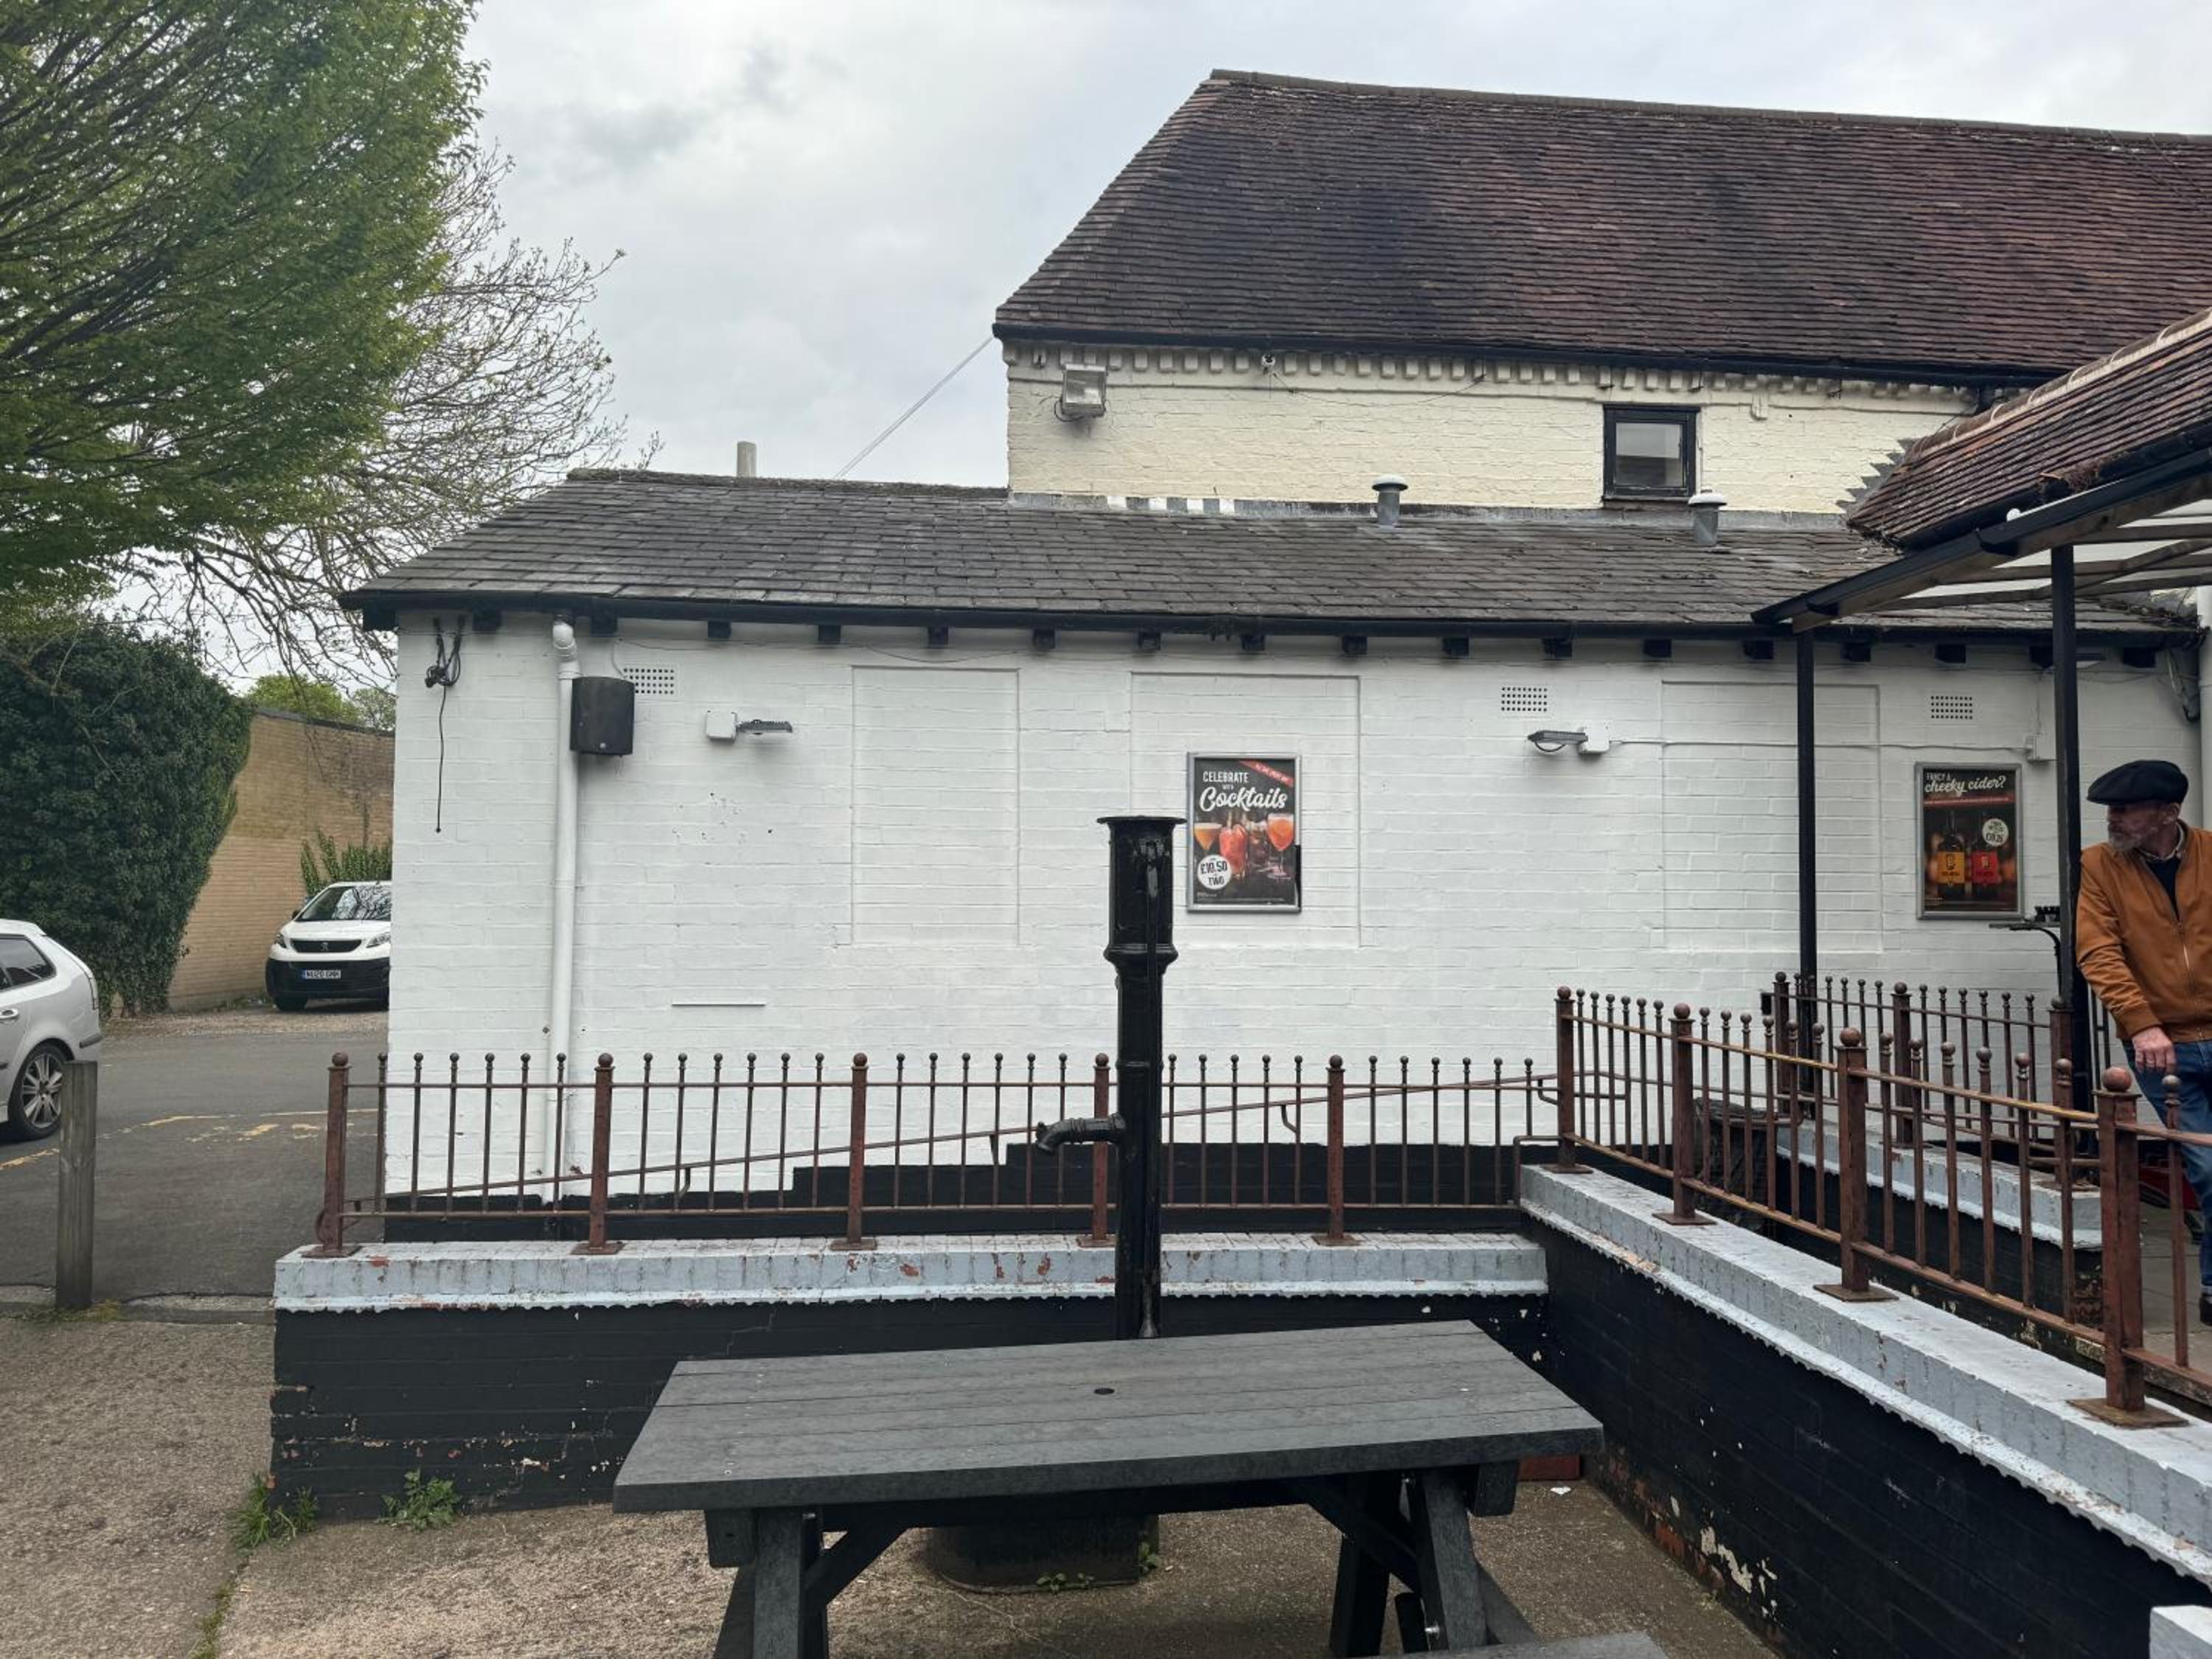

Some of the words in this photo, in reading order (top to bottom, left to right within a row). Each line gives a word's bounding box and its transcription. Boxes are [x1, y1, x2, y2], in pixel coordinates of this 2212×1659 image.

[1203, 771, 1249, 783] CELEBRATE
[1924, 779, 1967, 797] cheeky
[1968, 775, 2006, 790] cider?
[1200, 787, 1288, 812] Cocktails
[1208, 876, 1224, 886] TWO
